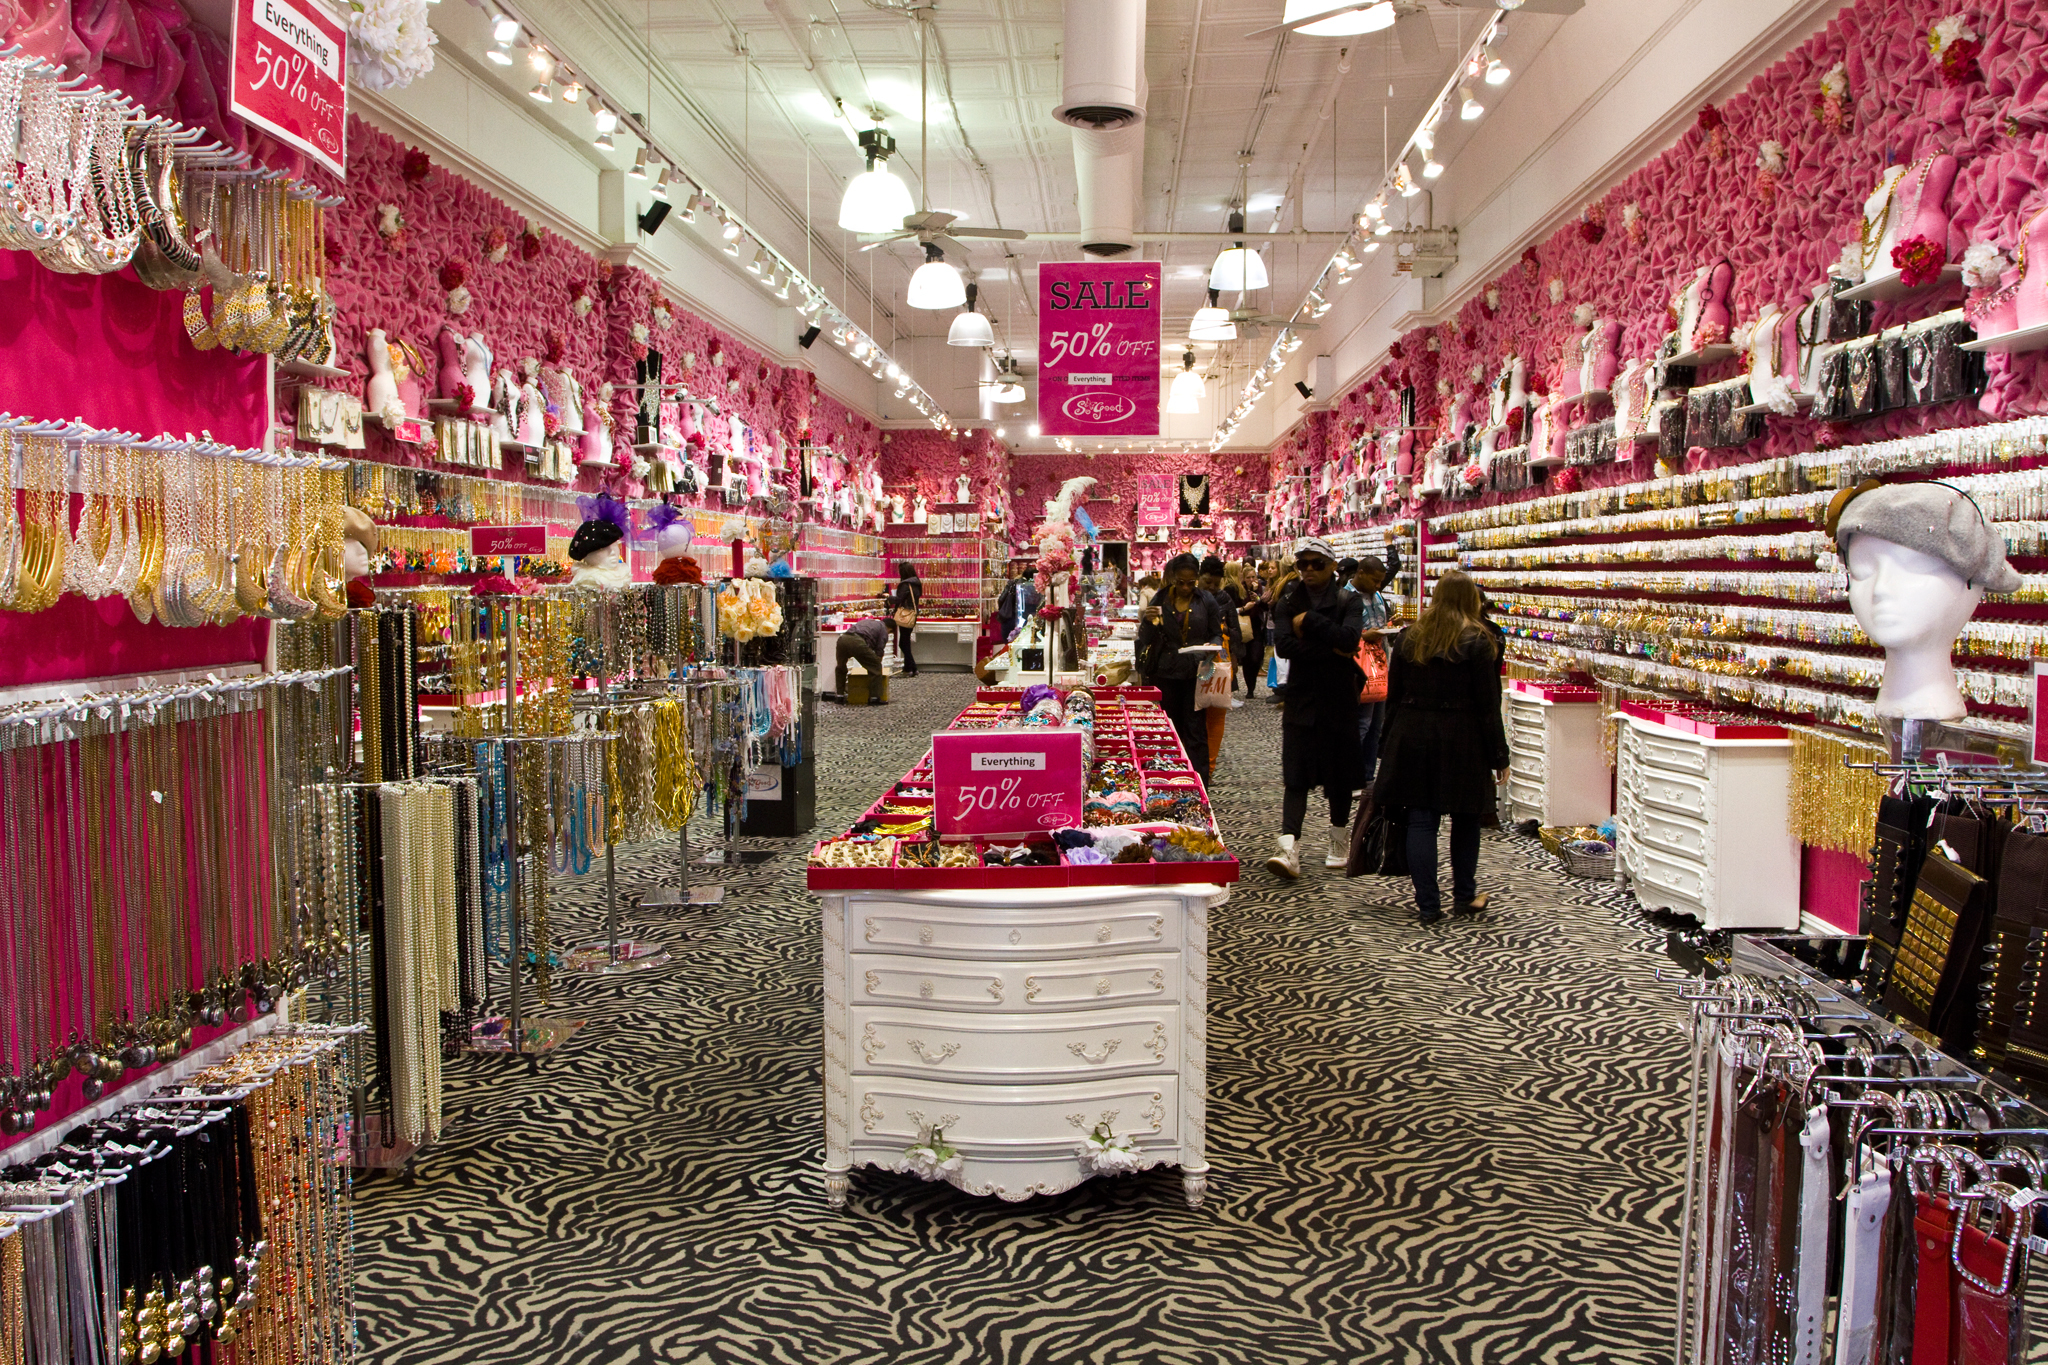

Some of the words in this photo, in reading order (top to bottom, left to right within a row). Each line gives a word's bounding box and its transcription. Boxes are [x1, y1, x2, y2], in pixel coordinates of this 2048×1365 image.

[265, 1, 329, 66] Everything
[249, 40, 308, 103] 50%
[311, 91, 334, 121] OFF
[1050, 281, 1150, 310] SALE
[1043, 322, 1113, 368] 50%
[1116, 340, 1155, 356] OFF
[1141, 479, 1171, 489] SALE
[1139, 492, 1160, 506] 50%
[489, 537, 513, 553] 50%
[981, 757, 1035, 768] Everything
[952, 776, 1022, 821] 50%
[1026, 792, 1065, 808] OFF
